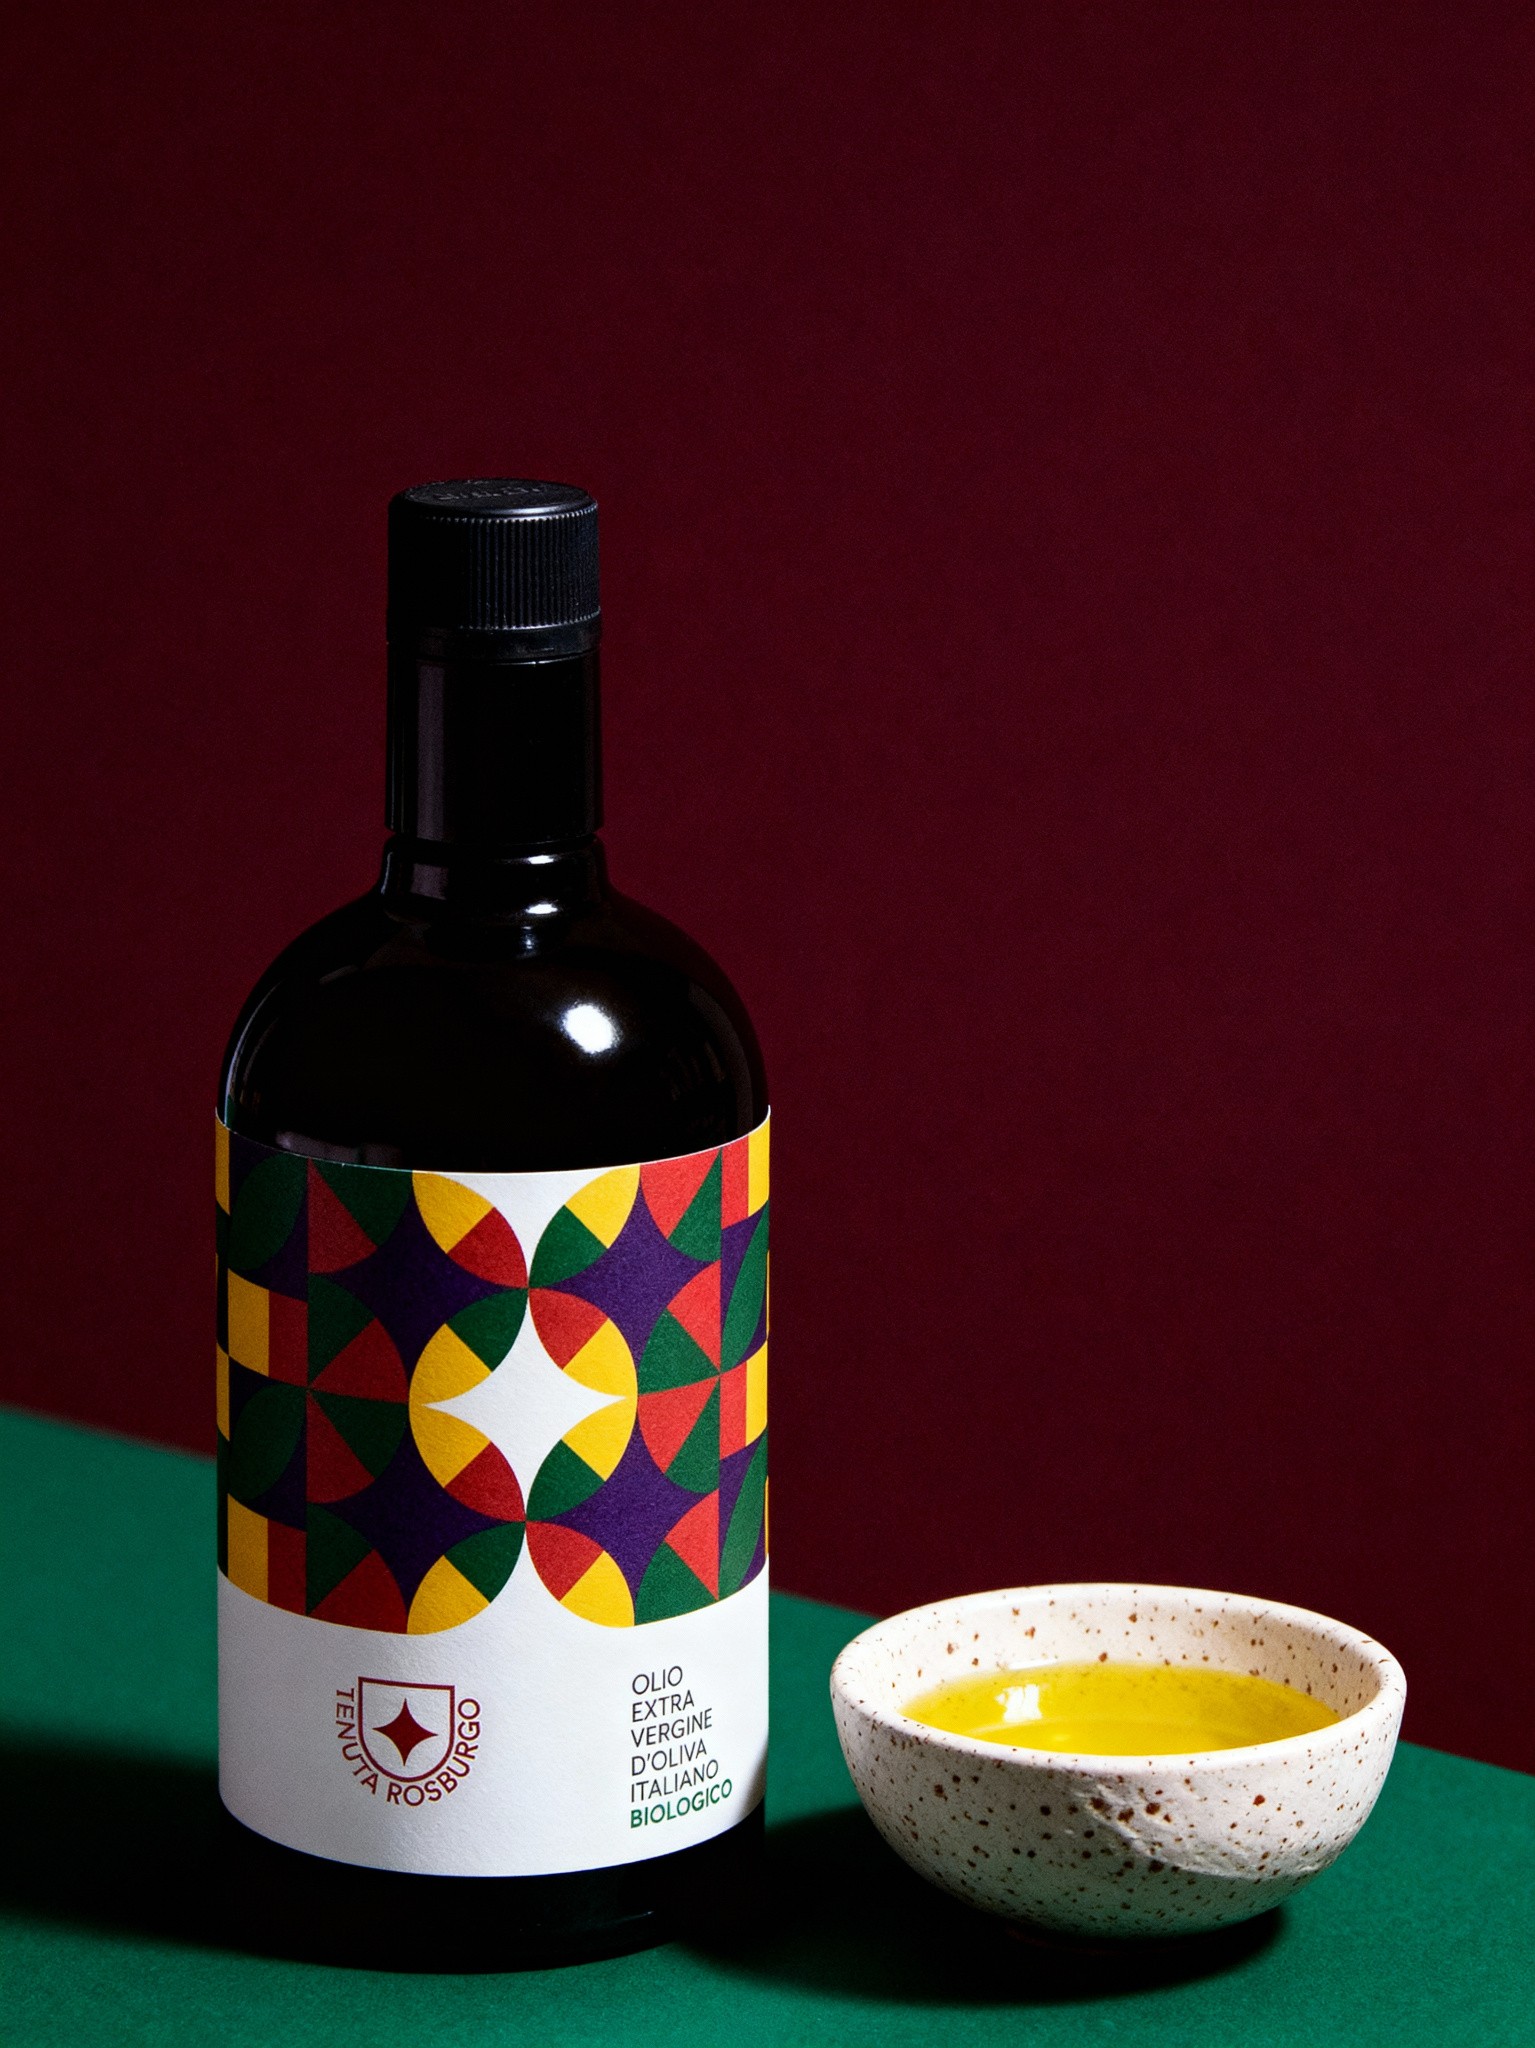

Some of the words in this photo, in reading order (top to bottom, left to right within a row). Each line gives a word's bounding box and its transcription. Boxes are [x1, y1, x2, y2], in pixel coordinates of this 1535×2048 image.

[631, 1665, 684, 1695] OLIO
[631, 1689, 695, 1723] EXTRA
[336, 1687, 379, 1795] TENUTA
[386, 1698, 481, 1807] ROSBURGO
[630, 1707, 713, 1748] VERGINE
[631, 1738, 708, 1776] D'OLIVA
[631, 1759, 719, 1803] ITALIANO
[630, 1778, 733, 1829] BIOLOGICO
